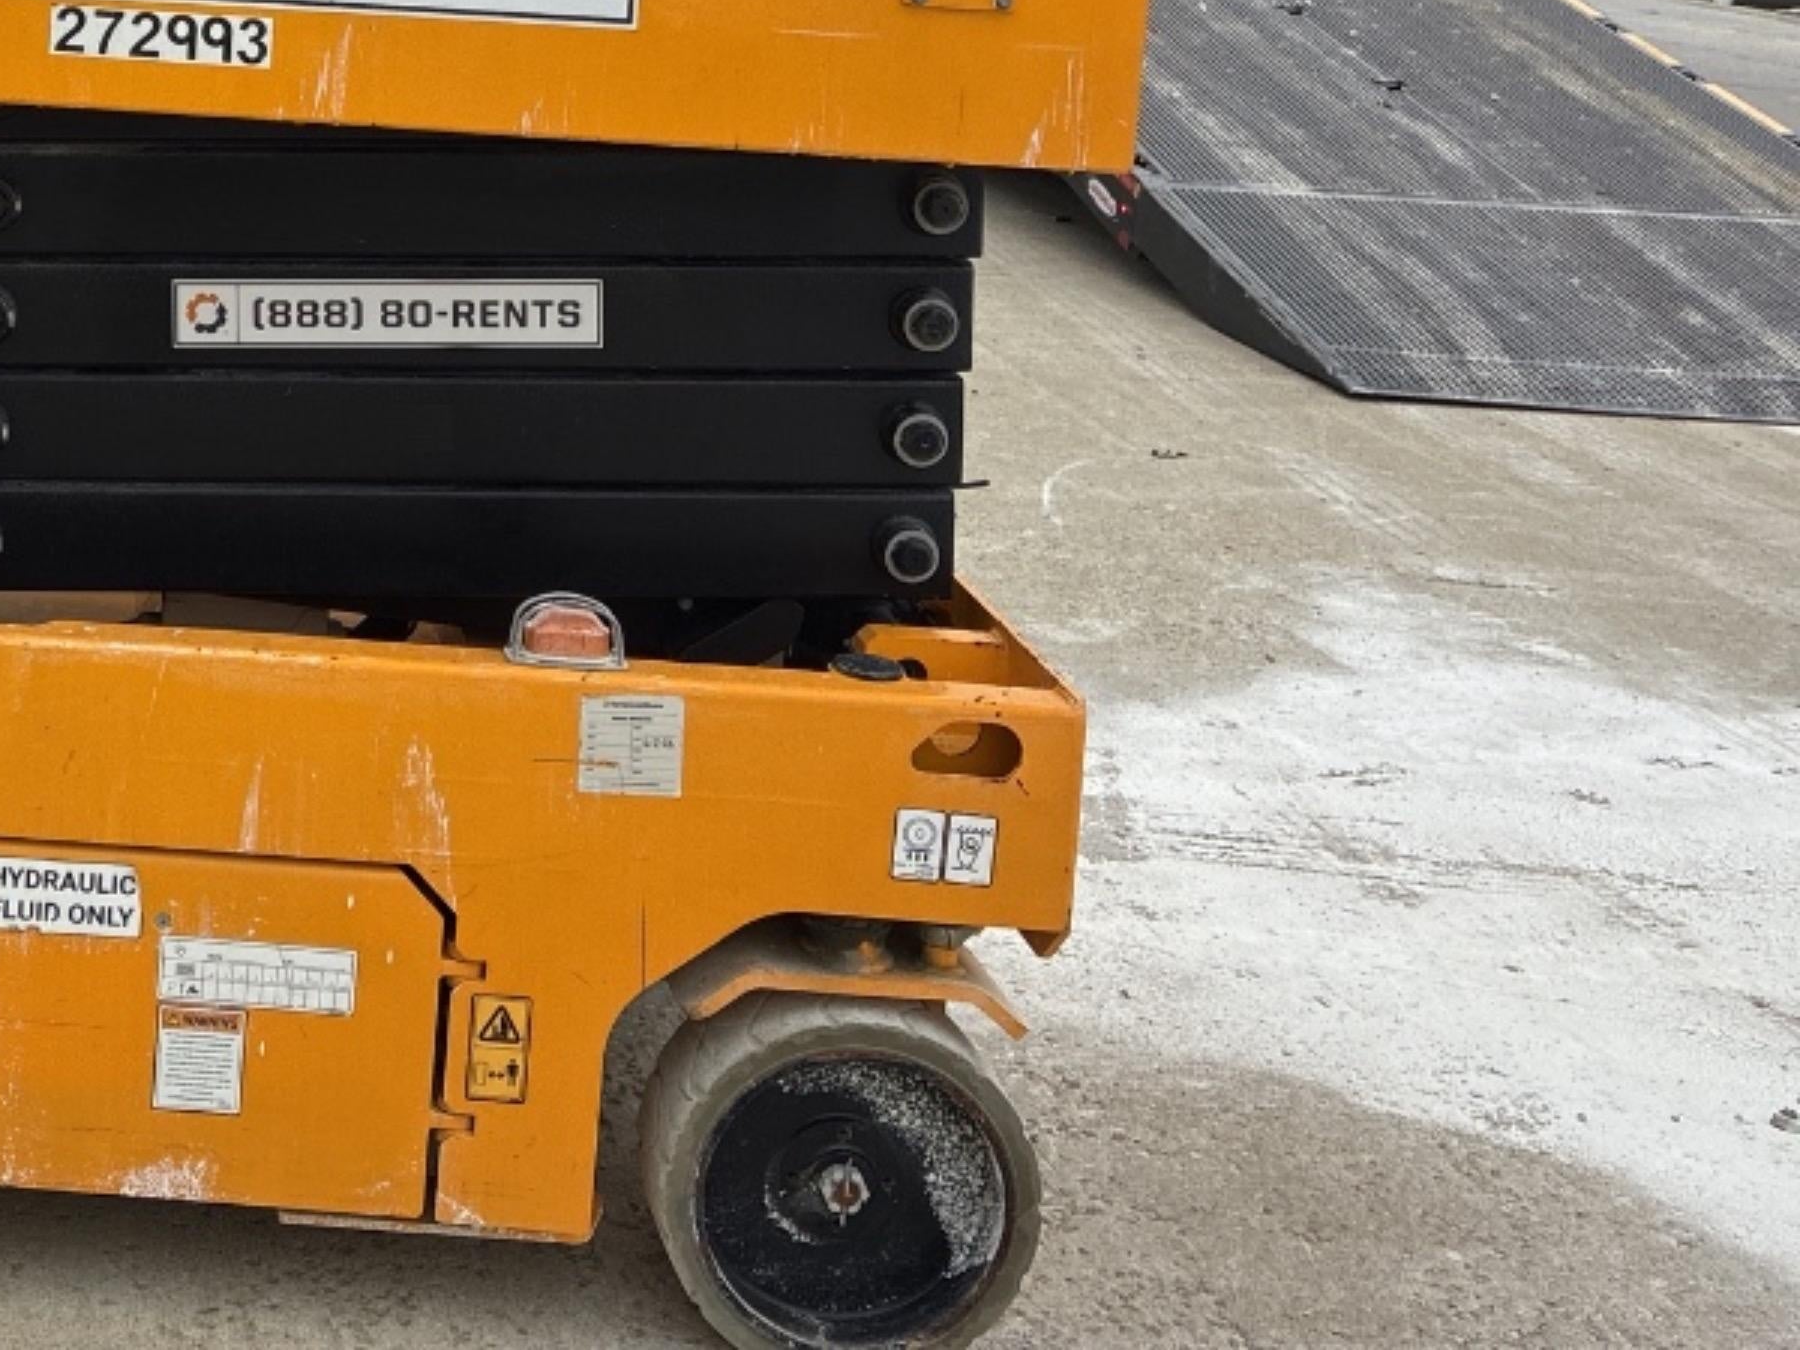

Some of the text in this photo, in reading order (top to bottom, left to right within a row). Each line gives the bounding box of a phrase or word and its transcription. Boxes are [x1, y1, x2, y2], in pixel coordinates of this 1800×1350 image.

[54, 6, 268, 65] 272993
[253, 296, 581, 330] (888) 80-RENTS
[67, 902, 134, 928] ONLY
